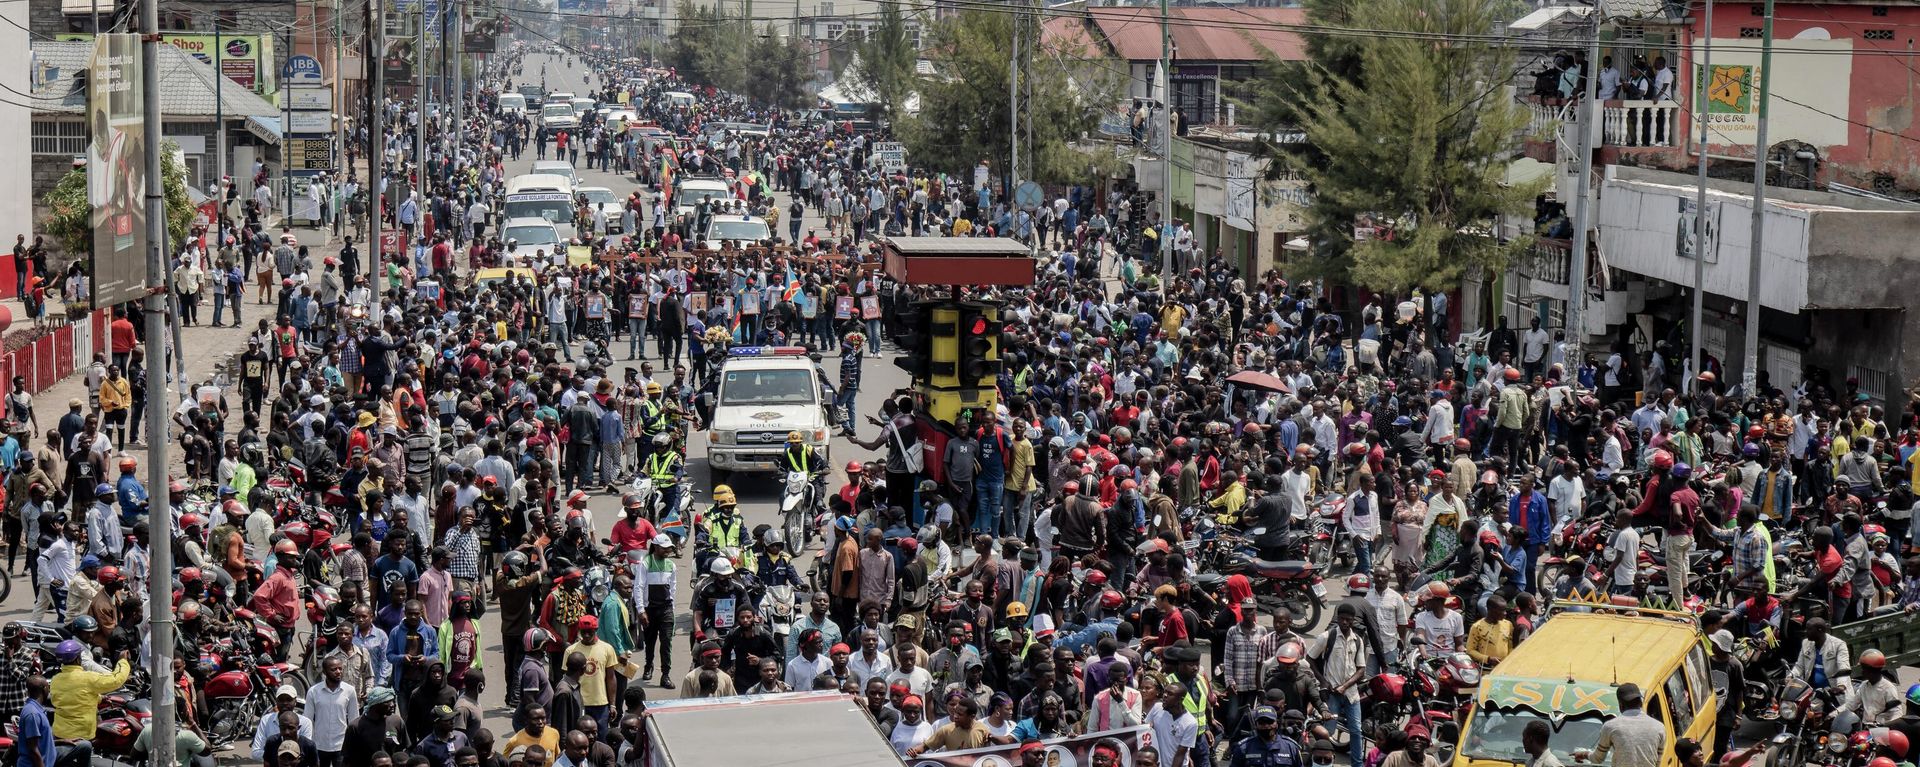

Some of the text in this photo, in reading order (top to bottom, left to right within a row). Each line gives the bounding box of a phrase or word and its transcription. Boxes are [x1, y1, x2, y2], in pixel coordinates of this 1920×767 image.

[173, 38, 204, 52] Shop
[293, 59, 315, 69] IBB
[1507, 681, 1610, 711] SIX
